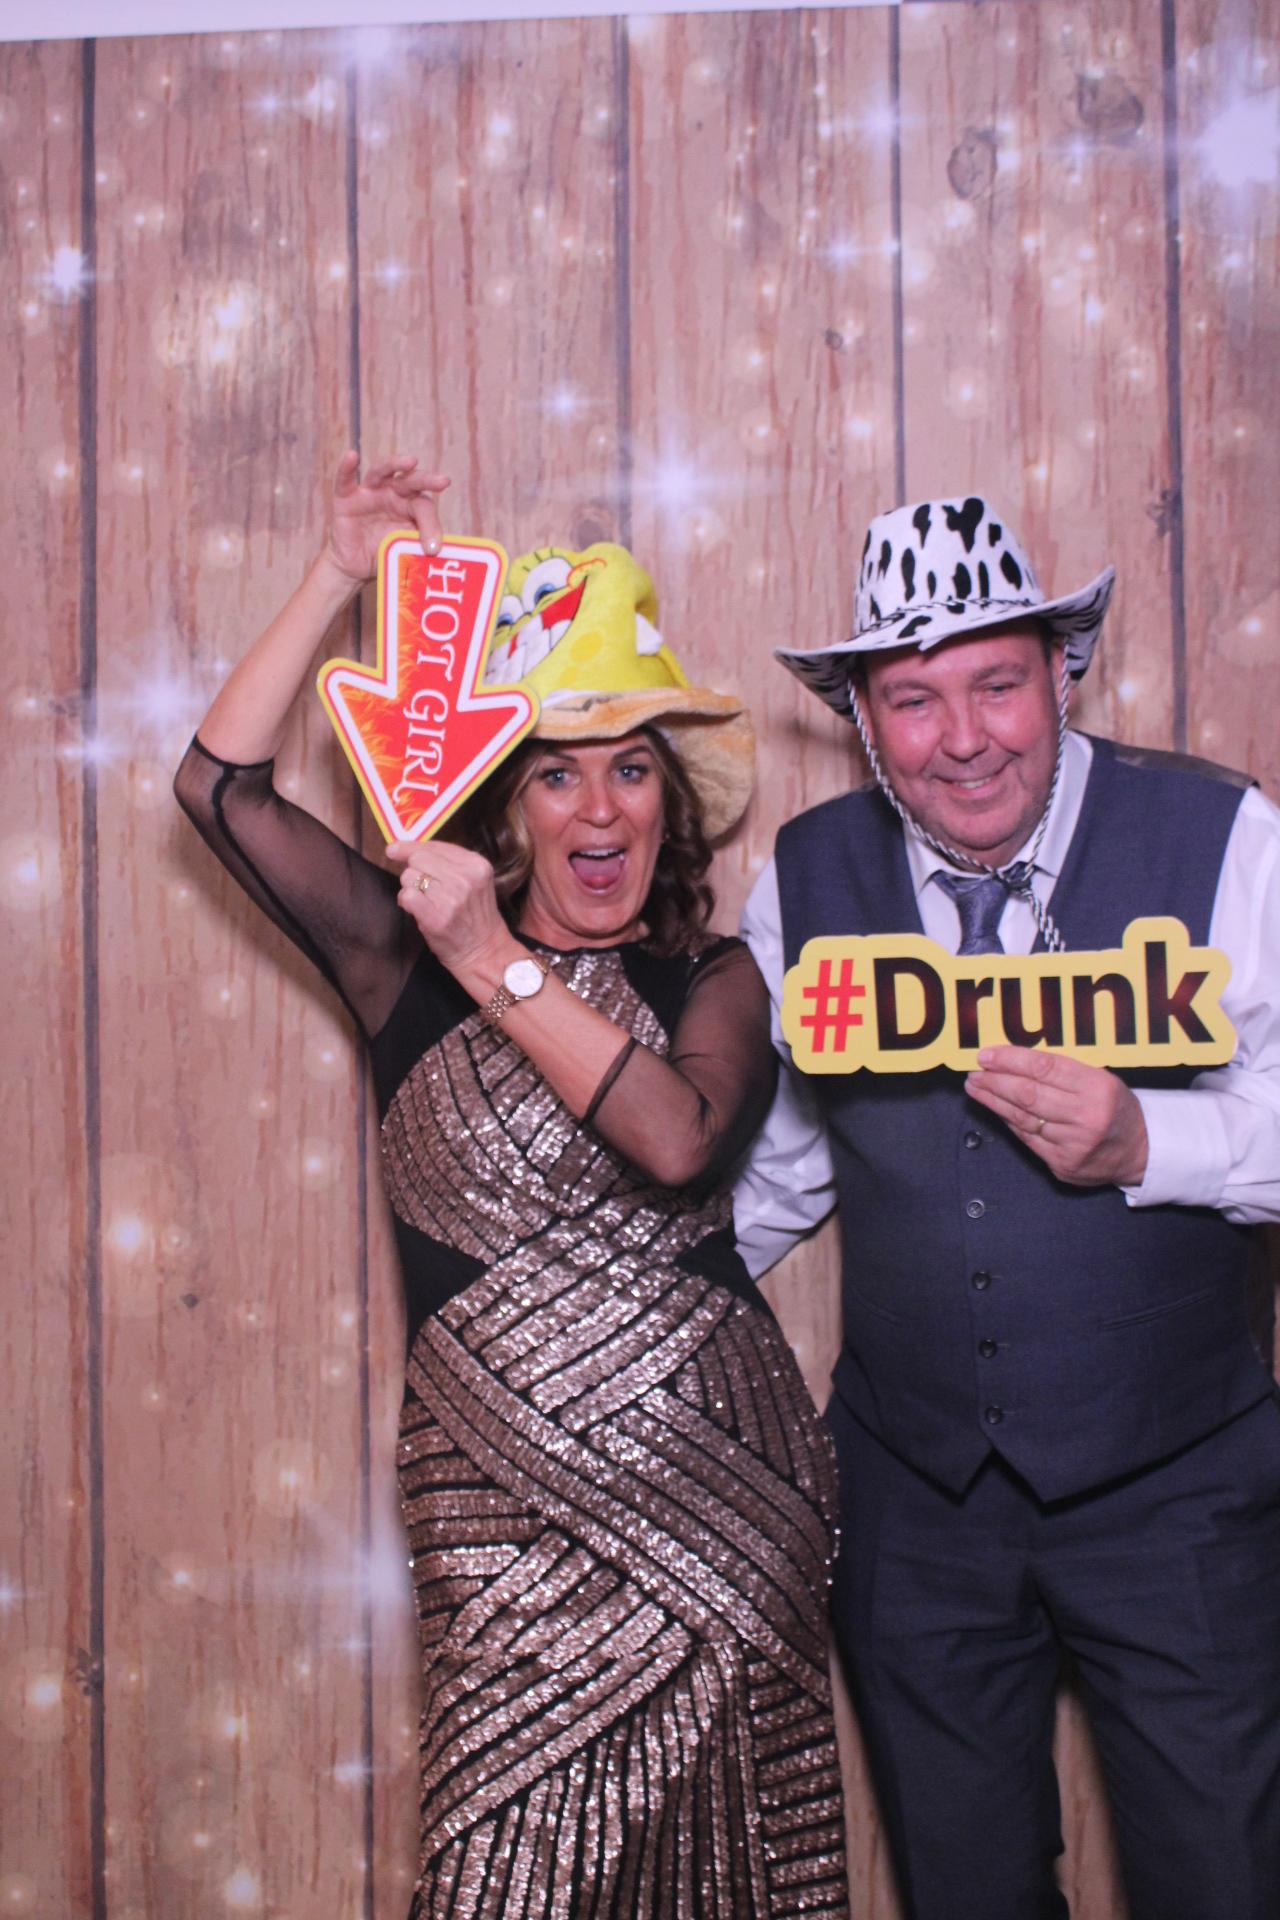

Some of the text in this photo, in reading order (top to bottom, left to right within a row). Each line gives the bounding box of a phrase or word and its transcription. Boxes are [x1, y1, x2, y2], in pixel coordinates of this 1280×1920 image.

[391, 560, 467, 806] HOT GIRL
[799, 941, 1217, 1053] #Drunk
